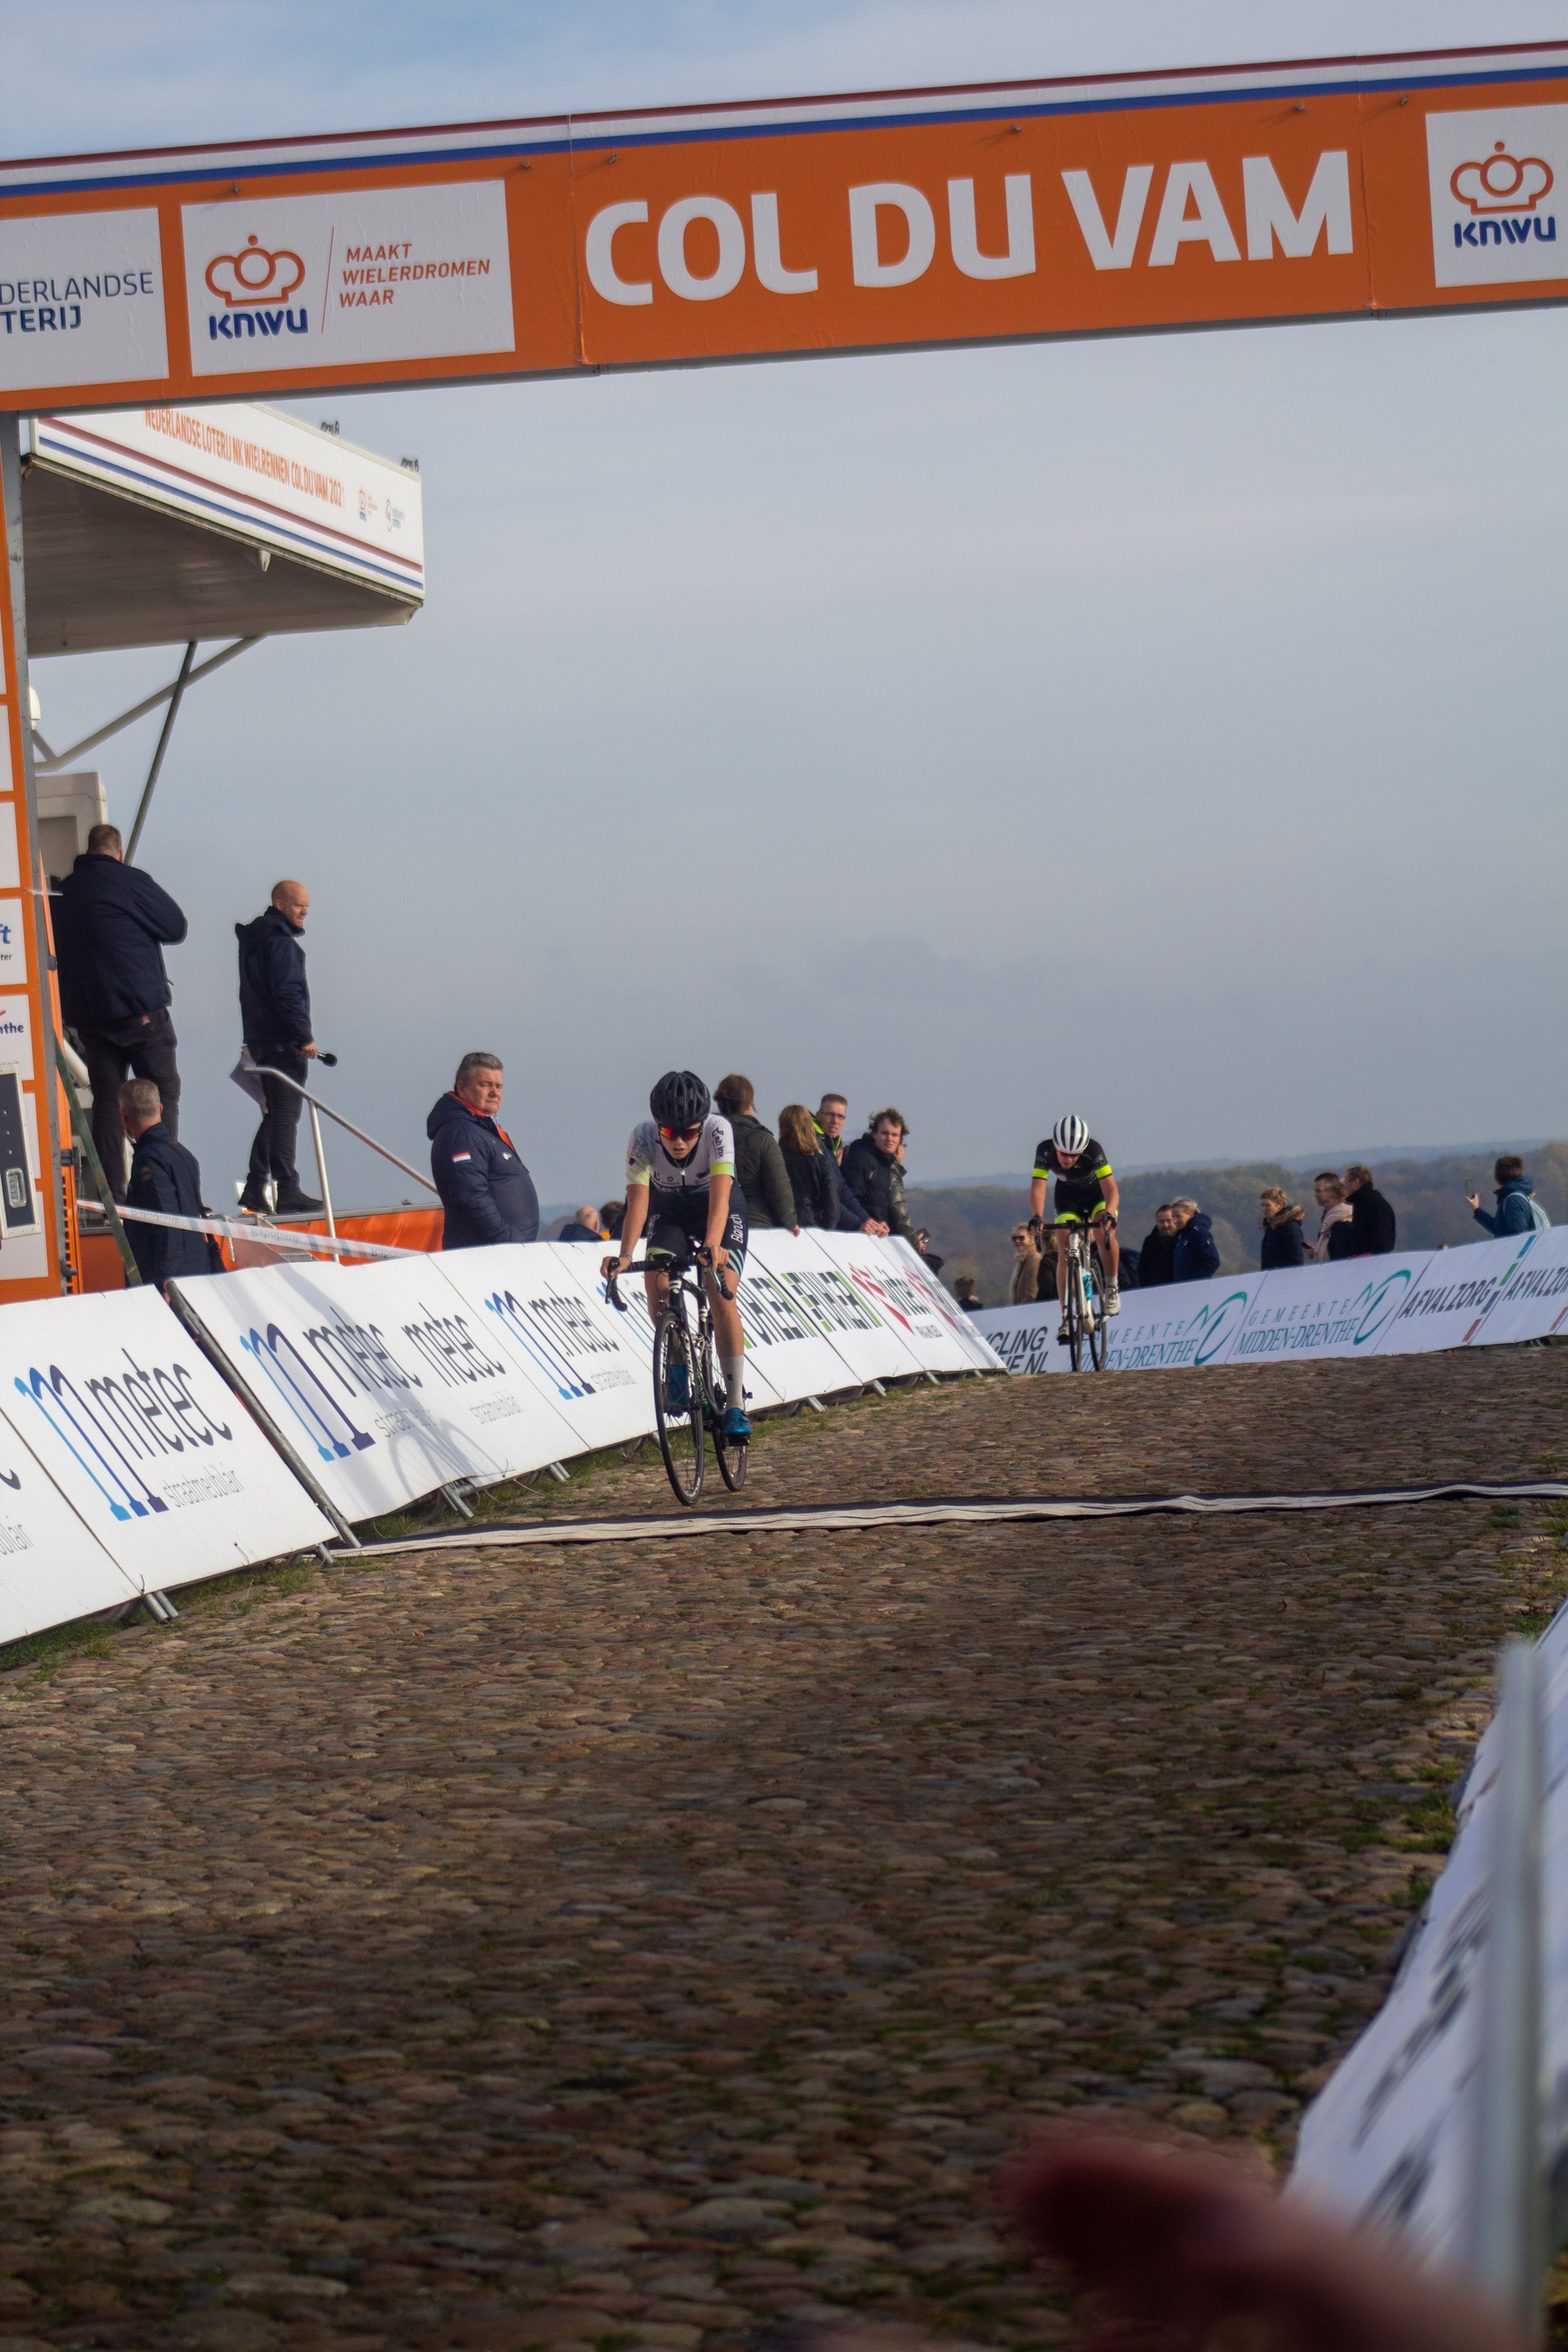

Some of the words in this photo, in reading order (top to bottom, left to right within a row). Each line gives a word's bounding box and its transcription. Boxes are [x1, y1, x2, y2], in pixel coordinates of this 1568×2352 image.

[584, 192, 819, 307] COL
[848, 173, 1036, 289] DU
[1060, 150, 1354, 271] VAM
[342, 259, 491, 286] WIELERDROMEN
[346, 242, 413, 263] MAAKT
[338, 289, 395, 309] WAAR
[145, 407, 201, 450] NEDERLANDSE
[201, 423, 231, 463] LOTERIJ
[232, 436, 244, 468] NK
[243, 440, 290, 486] WIELRENNEN
[290, 461, 304, 493] COL
[303, 466, 314, 496] DU
[313, 470, 328, 503] VAM
[328, 477, 345, 509] 2021
[527, 1280, 621, 1357] metec
[736, 1277, 815, 1348] UHLER
[1248, 1298, 1351, 1327] GEMEENTE
[1397, 1276, 1497, 1319] AFVALZORG
[302, 1305, 423, 1398] metec
[400, 1301, 507, 1388] metec
[1232, 1317, 1360, 1356] MIDDEN-DRENTHE
[83, 1348, 233, 1461] metec
[162, 1462, 247, 1508] straatmeubilair
